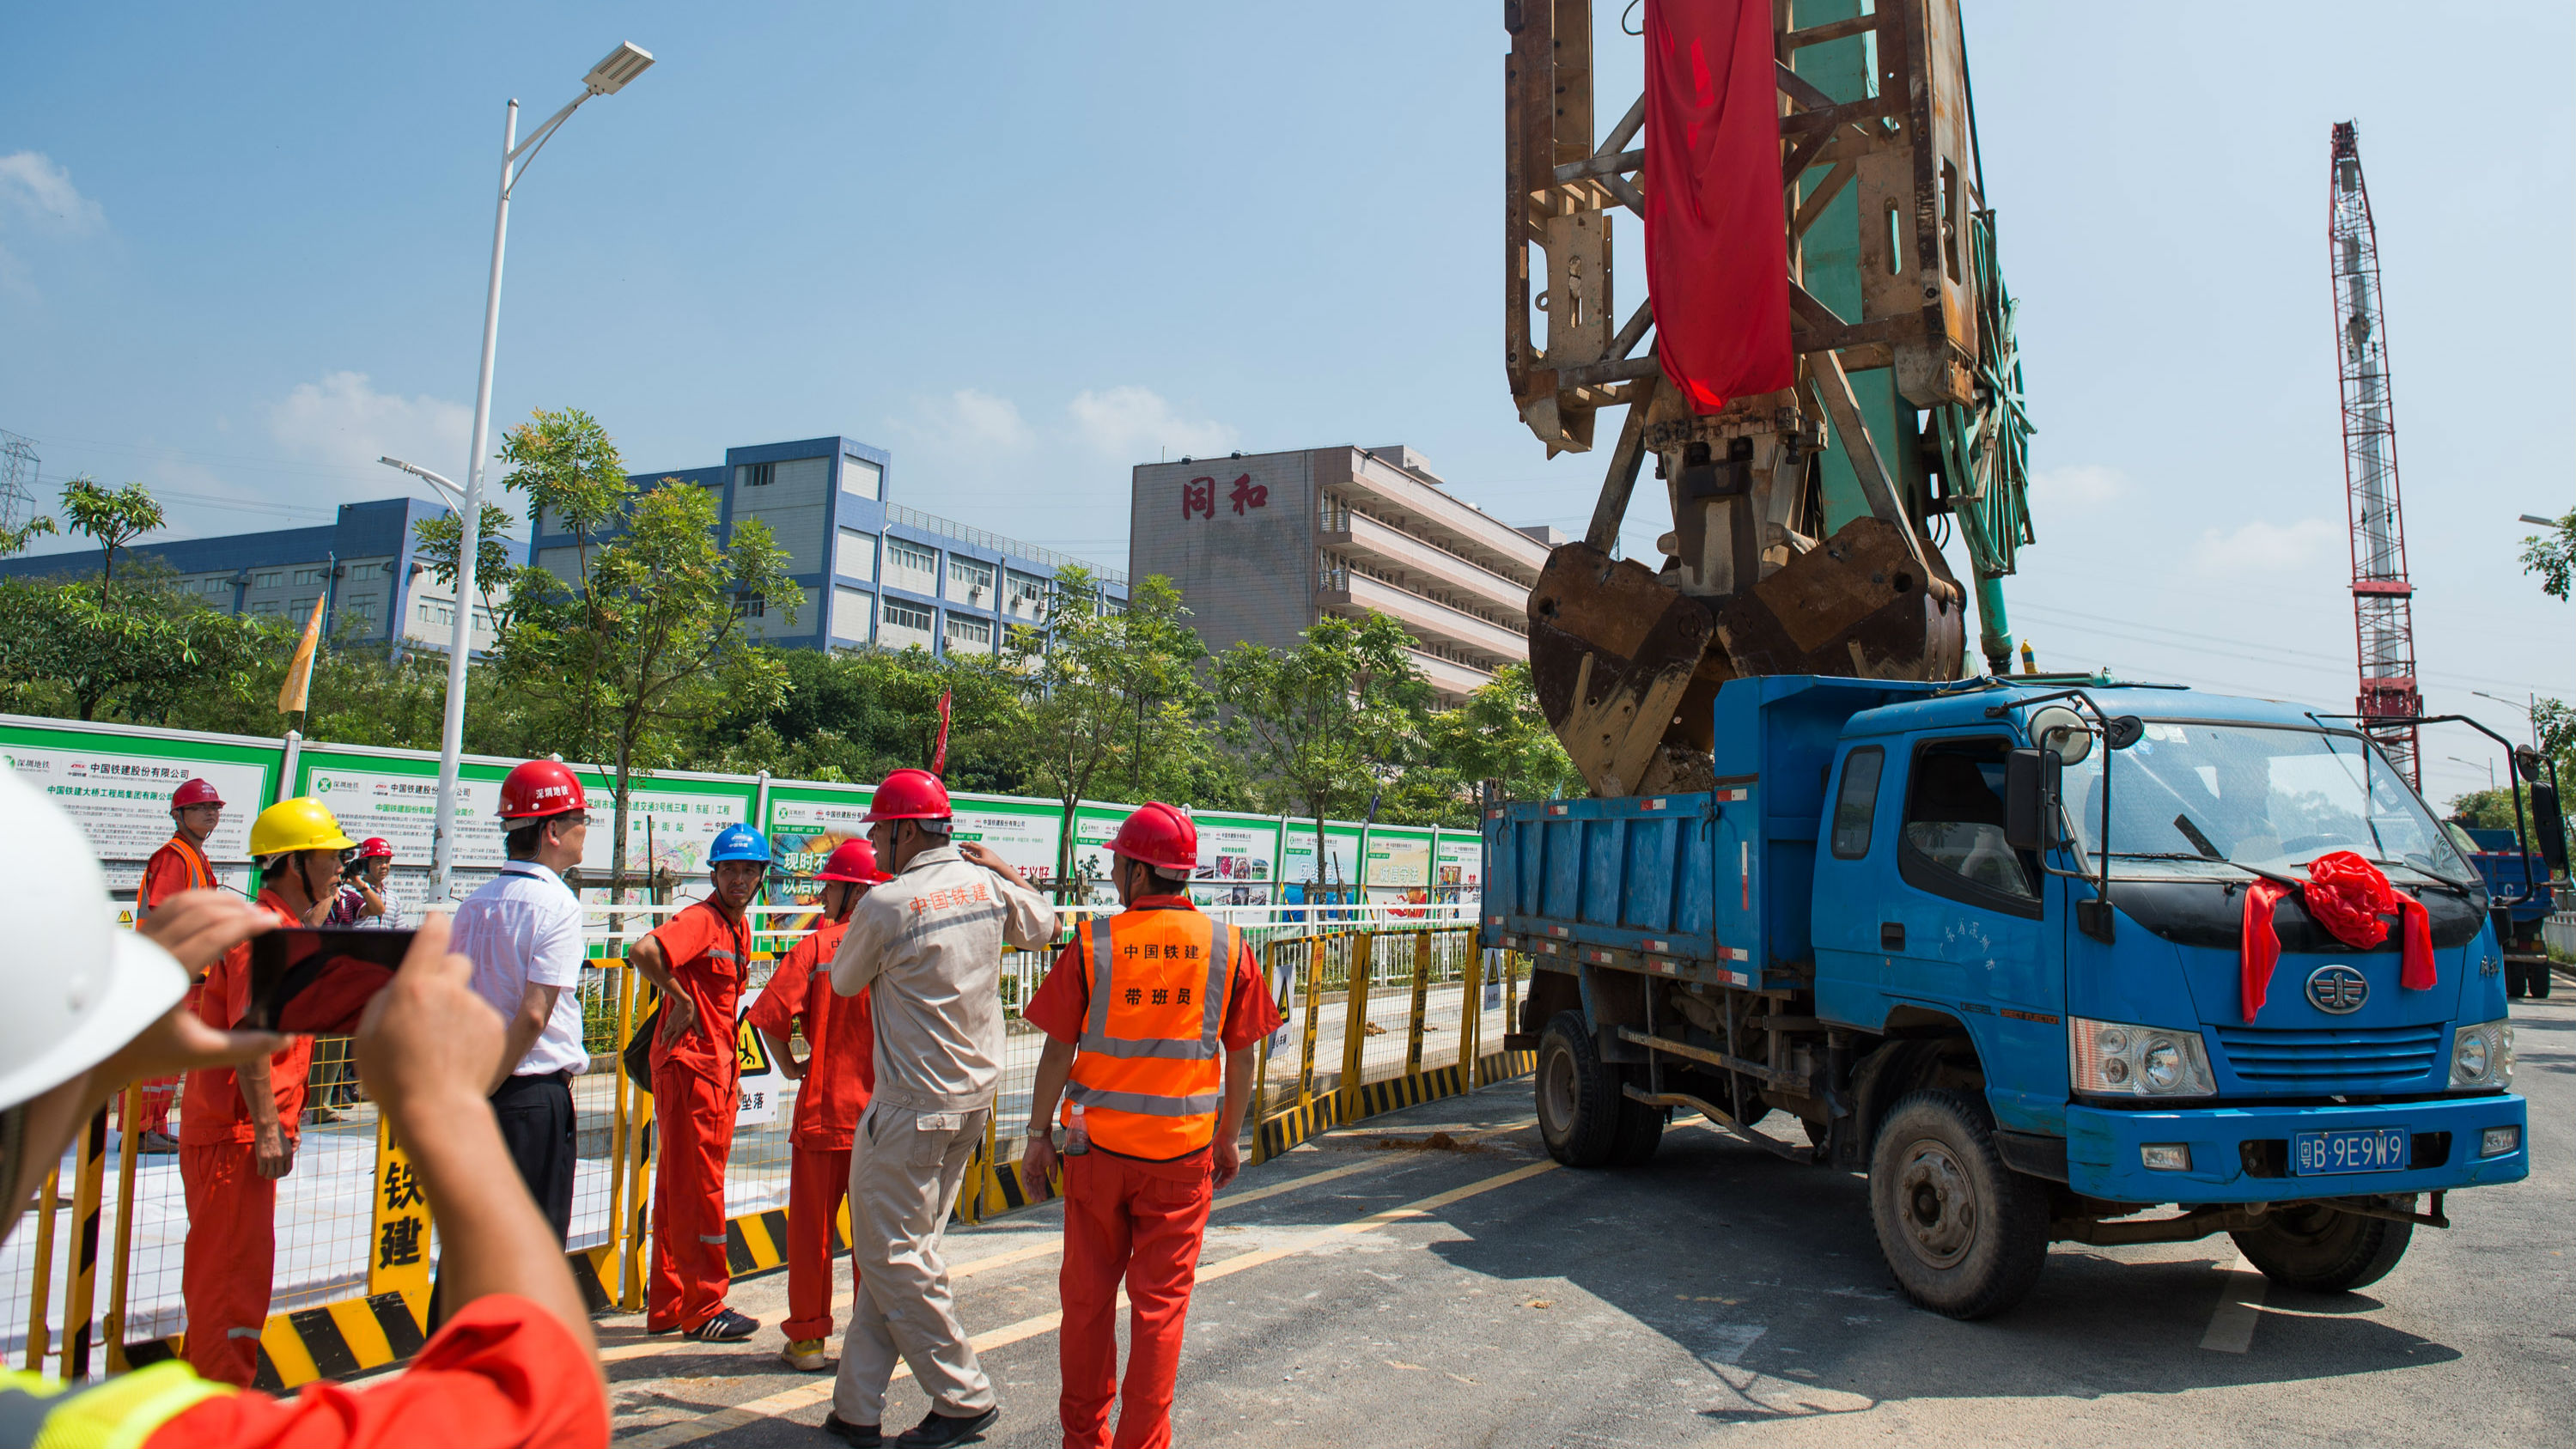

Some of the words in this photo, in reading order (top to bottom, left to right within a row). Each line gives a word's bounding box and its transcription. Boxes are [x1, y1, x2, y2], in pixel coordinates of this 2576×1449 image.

[1183, 472, 1269, 520] 同和
[17, 759, 50, 770] 深圳地铁
[90, 762, 190, 780] 中国铁建股份有限公司
[391, 782, 471, 797] 中国铁建股份公司
[535, 784, 569, 800] 深圳地铁
[715, 820, 740, 830] 中国铁
[1010, 863, 1050, 878] 主义好
[909, 883, 991, 916] 中国铁建
[1124, 944, 1200, 960] 中国铁建
[1124, 988, 1191, 1006] 带班员
[1411, 964, 1428, 1064] 中国铁建
[1303, 976, 1321, 1093] 中国铁建
[741, 1091, 764, 1111] 坠落
[378, 1122, 426, 1270] 铁建
